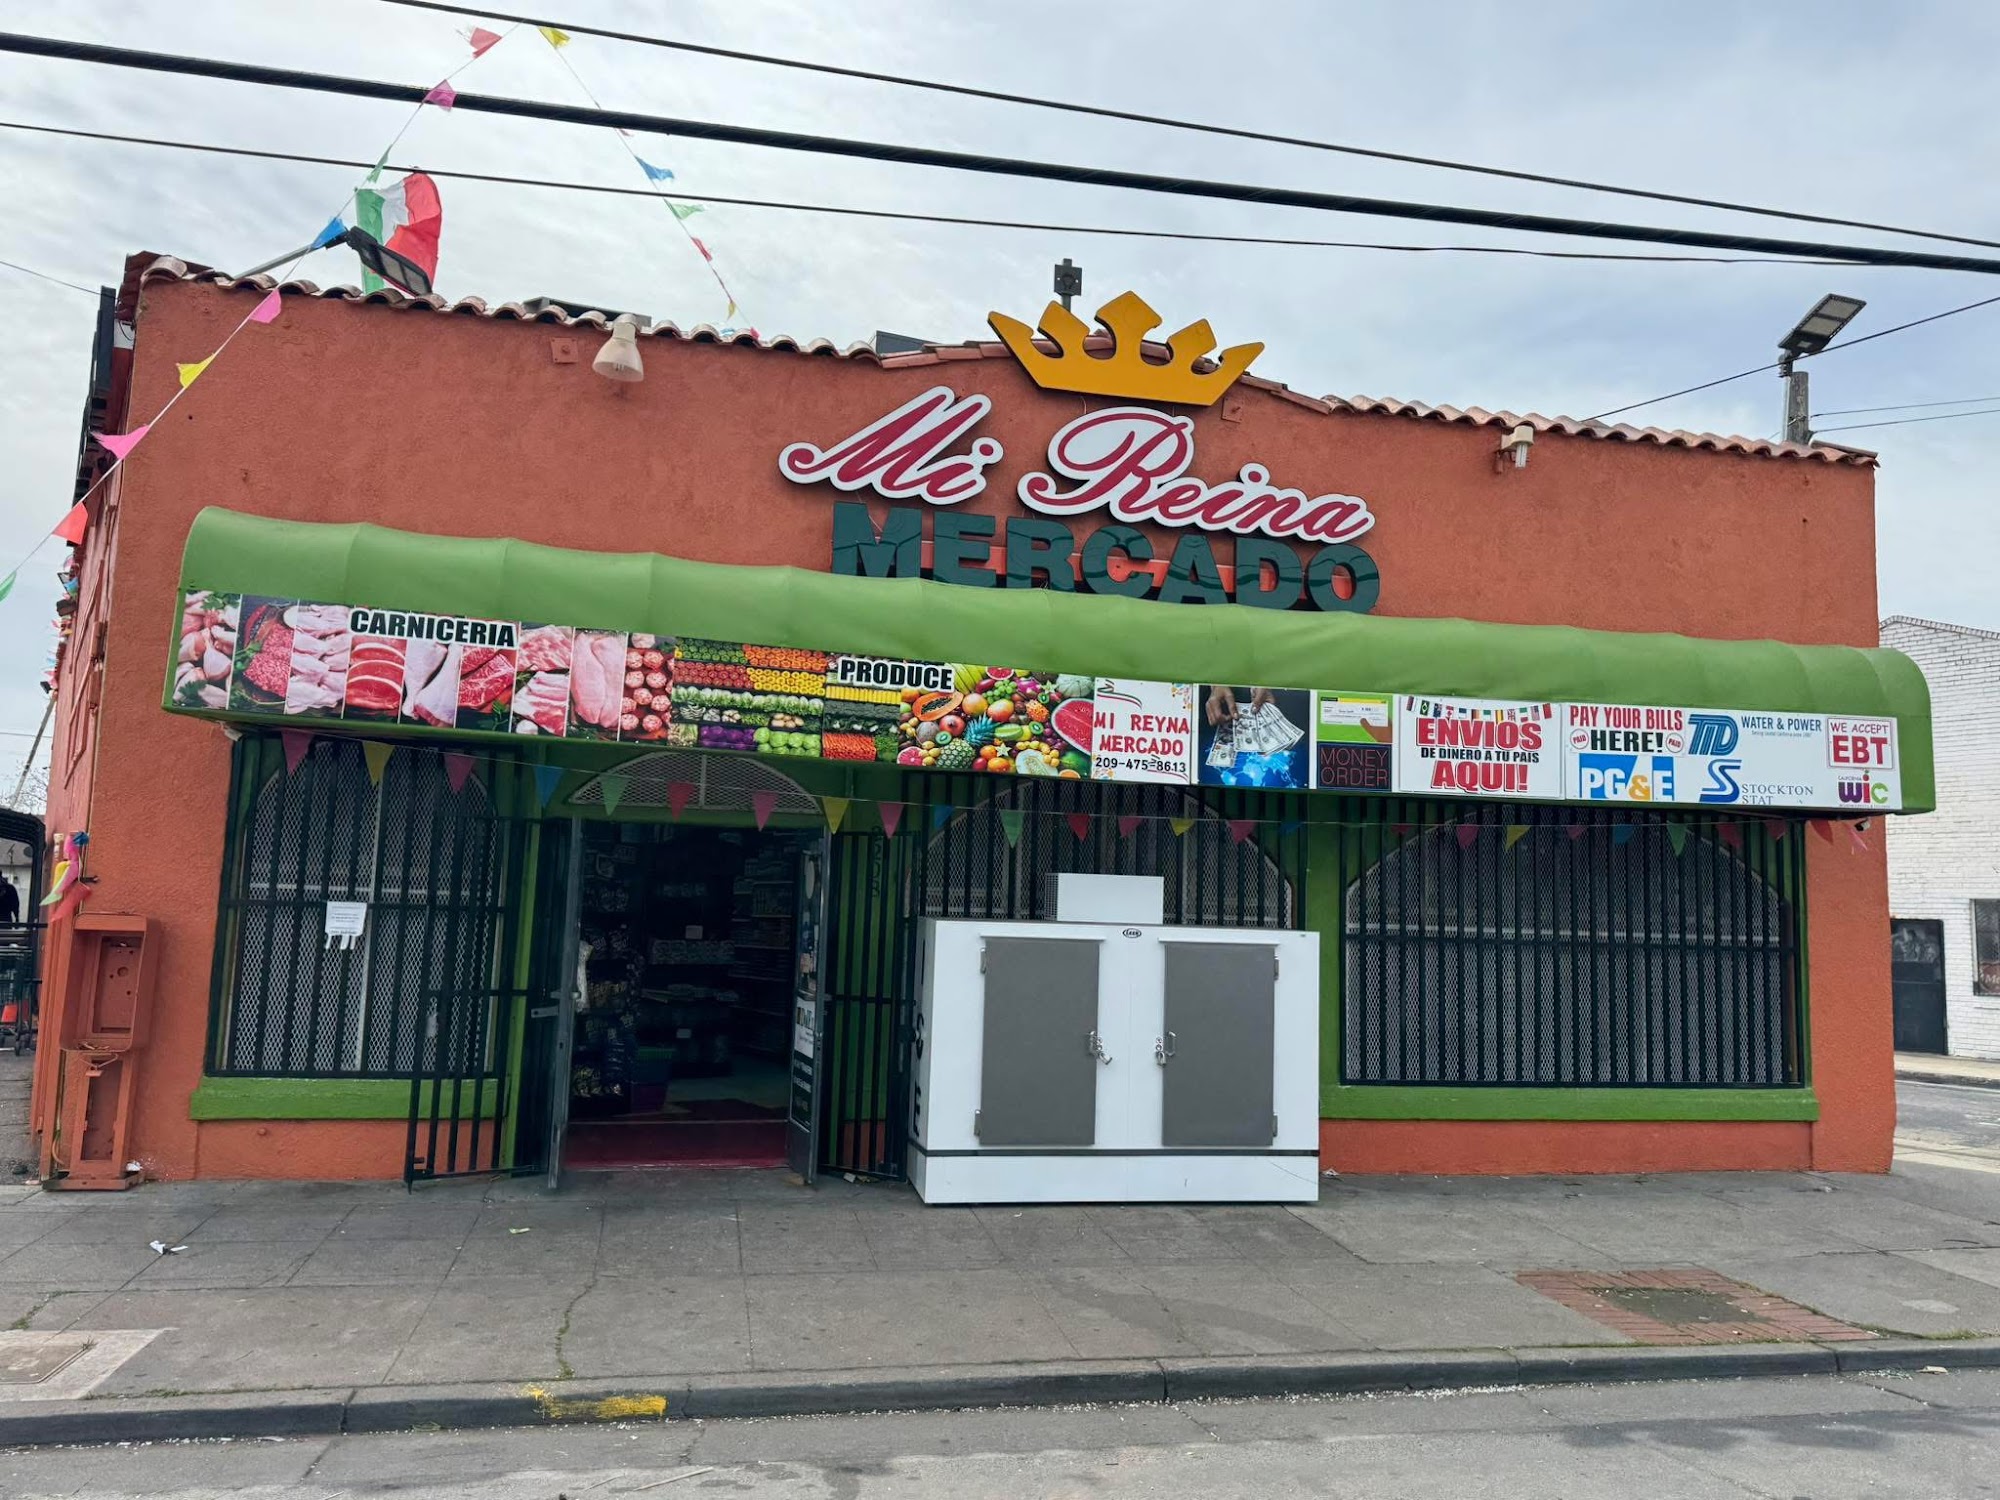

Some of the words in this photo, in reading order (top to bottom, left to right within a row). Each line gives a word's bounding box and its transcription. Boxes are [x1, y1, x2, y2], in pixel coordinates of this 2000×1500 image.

[781, 389, 1000, 502] Mi
[1020, 408, 1375, 541] Reina
[832, 502, 1380, 613] MERCADO
[350, 610, 515, 648] CARNICERIA
[840, 659, 953, 690] PRODUCE
[1094, 711, 1115, 730] MI
[1130, 713, 1190, 735] REYNA
[1570, 705, 1599, 727] PAY
[1604, 706, 1640, 729] YOUR
[1646, 708, 1683, 731] BILLS
[1741, 716, 1774, 729] WATER
[1776, 718, 1785, 730] &
[1787, 718, 1822, 732] POWER
[1830, 722, 1847, 733] WE
[1851, 723, 1889, 735] ACCEPT
[1099, 734, 1184, 756] MERCADO
[1416, 717, 1543, 751] ENVIOS
[1590, 729, 1664, 753] HERE!
[1320, 747, 1389, 767] MONEY
[1421, 747, 1436, 759] DE
[1439, 748, 1482, 761] DINERO
[1484, 751, 1493, 761] A
[1494, 751, 1510, 762] TU
[1513, 751, 1540, 763] PAIS
[1832, 735, 1888, 765] EBT
[1095, 757, 1186, 773] 209-475-8613
[1320, 766, 1389, 787] ORDER
[1431, 760, 1529, 793] AQUI!
[1580, 767, 1674, 801] PG&E
[1741, 783, 1814, 796] STOCKTON
